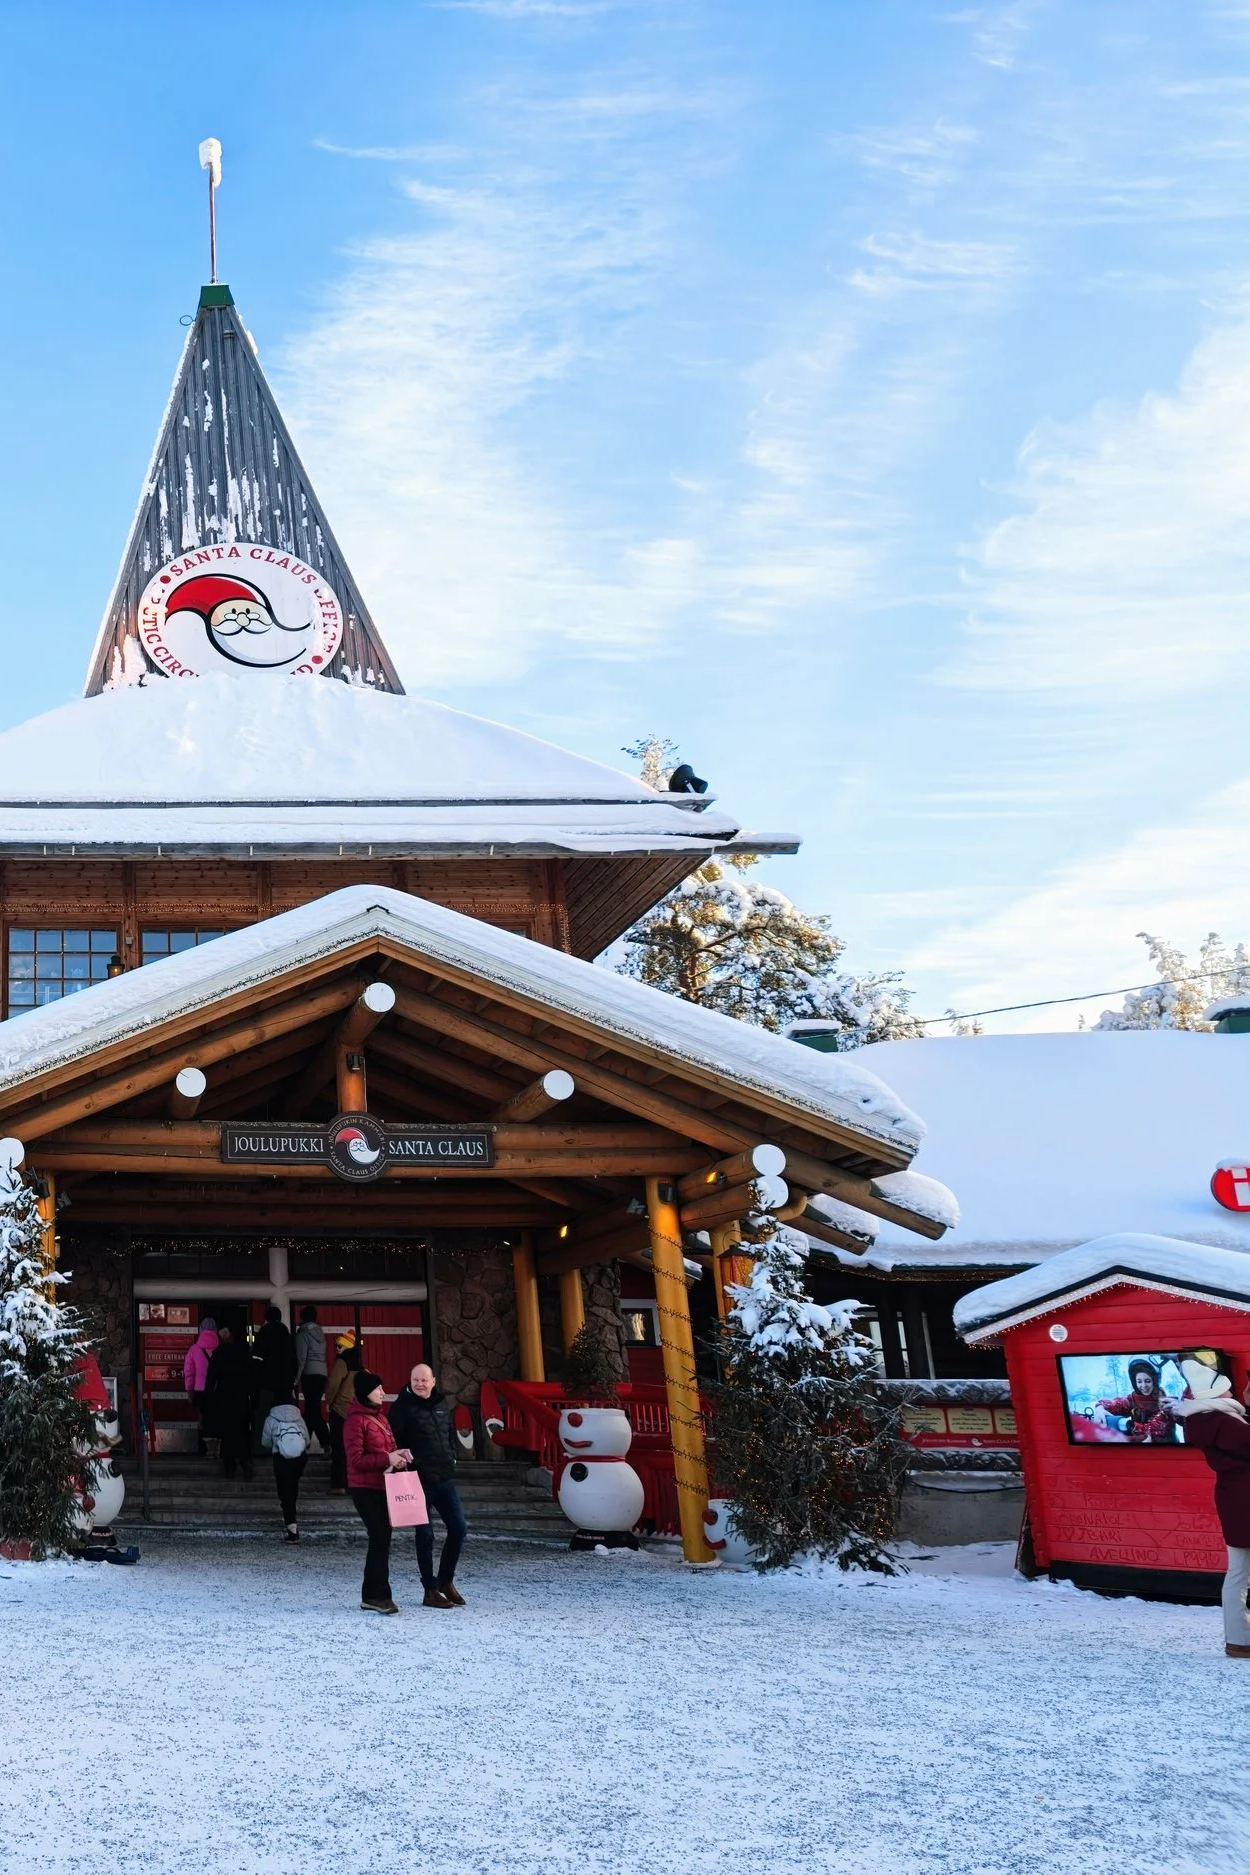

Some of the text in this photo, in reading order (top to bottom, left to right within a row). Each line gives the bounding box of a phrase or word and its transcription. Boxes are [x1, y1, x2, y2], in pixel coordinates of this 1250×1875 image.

[170, 546, 241, 577] SANTA
[250, 548, 316, 584] CLAUS
[234, 1136, 324, 1153] JOULUPUKKI
[389, 1140, 484, 1156] SANTA CLAUS
